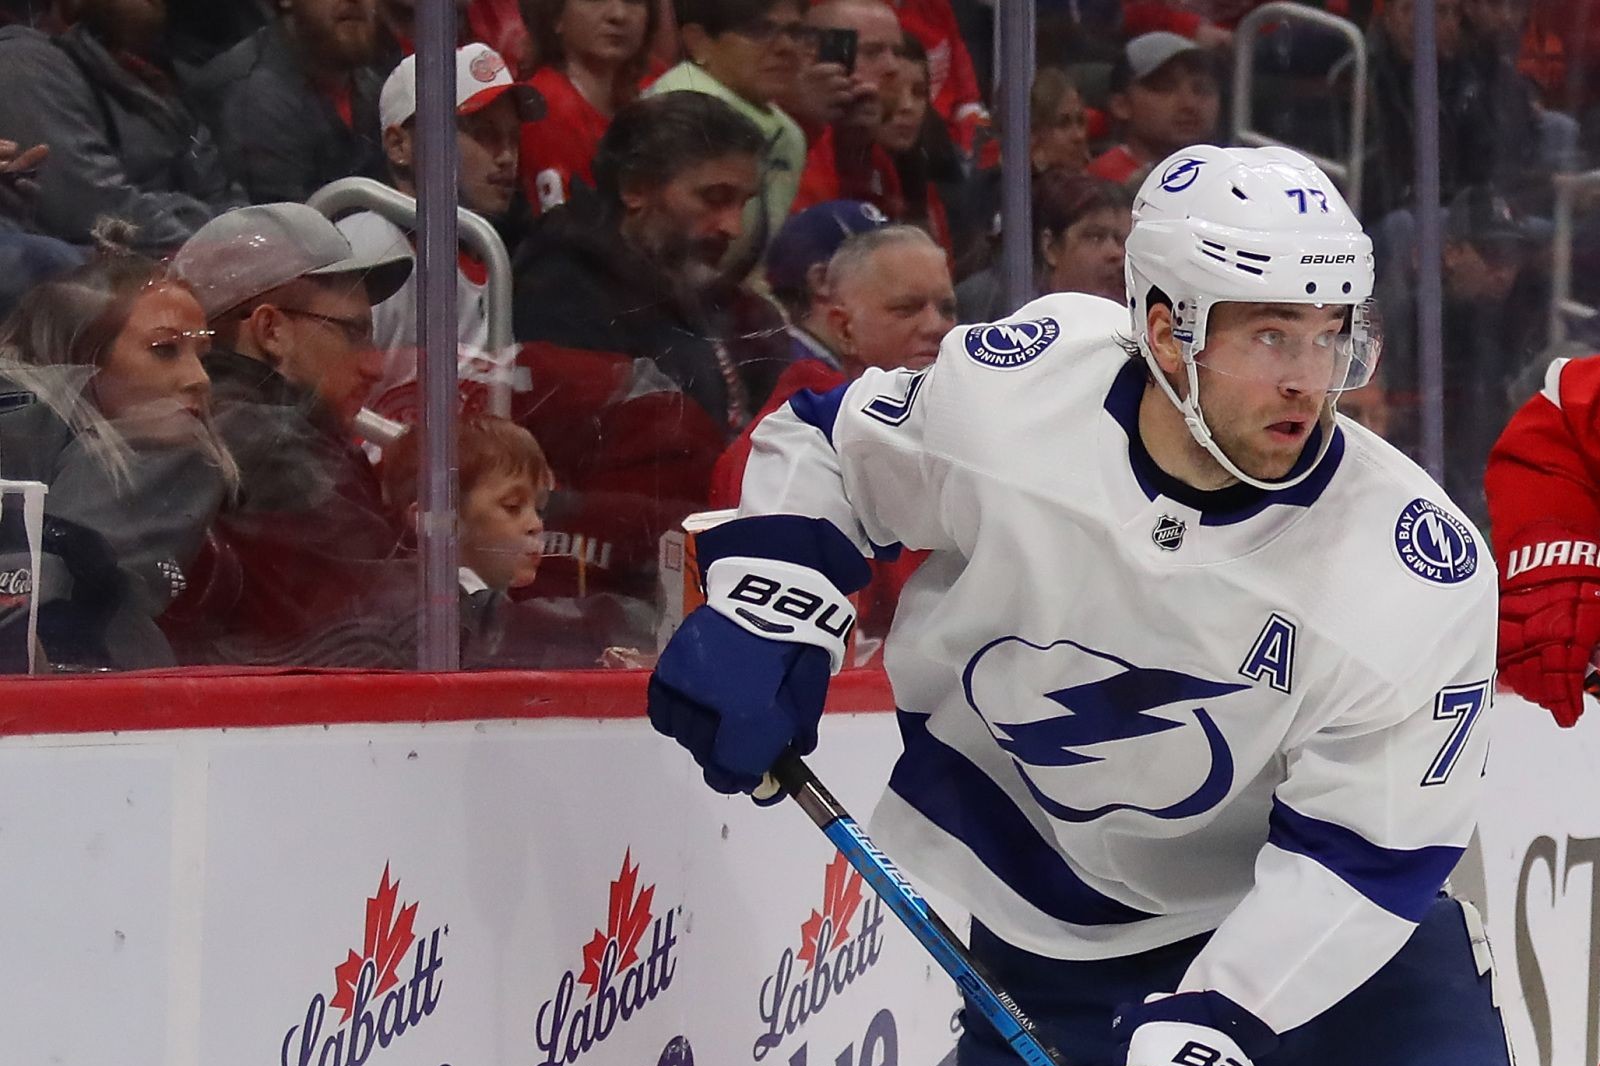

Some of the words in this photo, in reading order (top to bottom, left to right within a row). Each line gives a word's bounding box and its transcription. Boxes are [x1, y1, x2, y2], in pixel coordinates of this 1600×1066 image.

[1285, 188, 1330, 214] 77
[1300, 254, 1356, 265] BAUER
[1157, 528, 1180, 541] NHL
[1399, 512, 1414, 540] BAY
[1402, 543, 1443, 579] TAMPA
[727, 573, 854, 642] BAU
[1238, 612, 1297, 695] A
[1420, 678, 1498, 787] 7
[753, 894, 886, 1062] Labatt
[997, 991, 1037, 1032] HEDMAN
